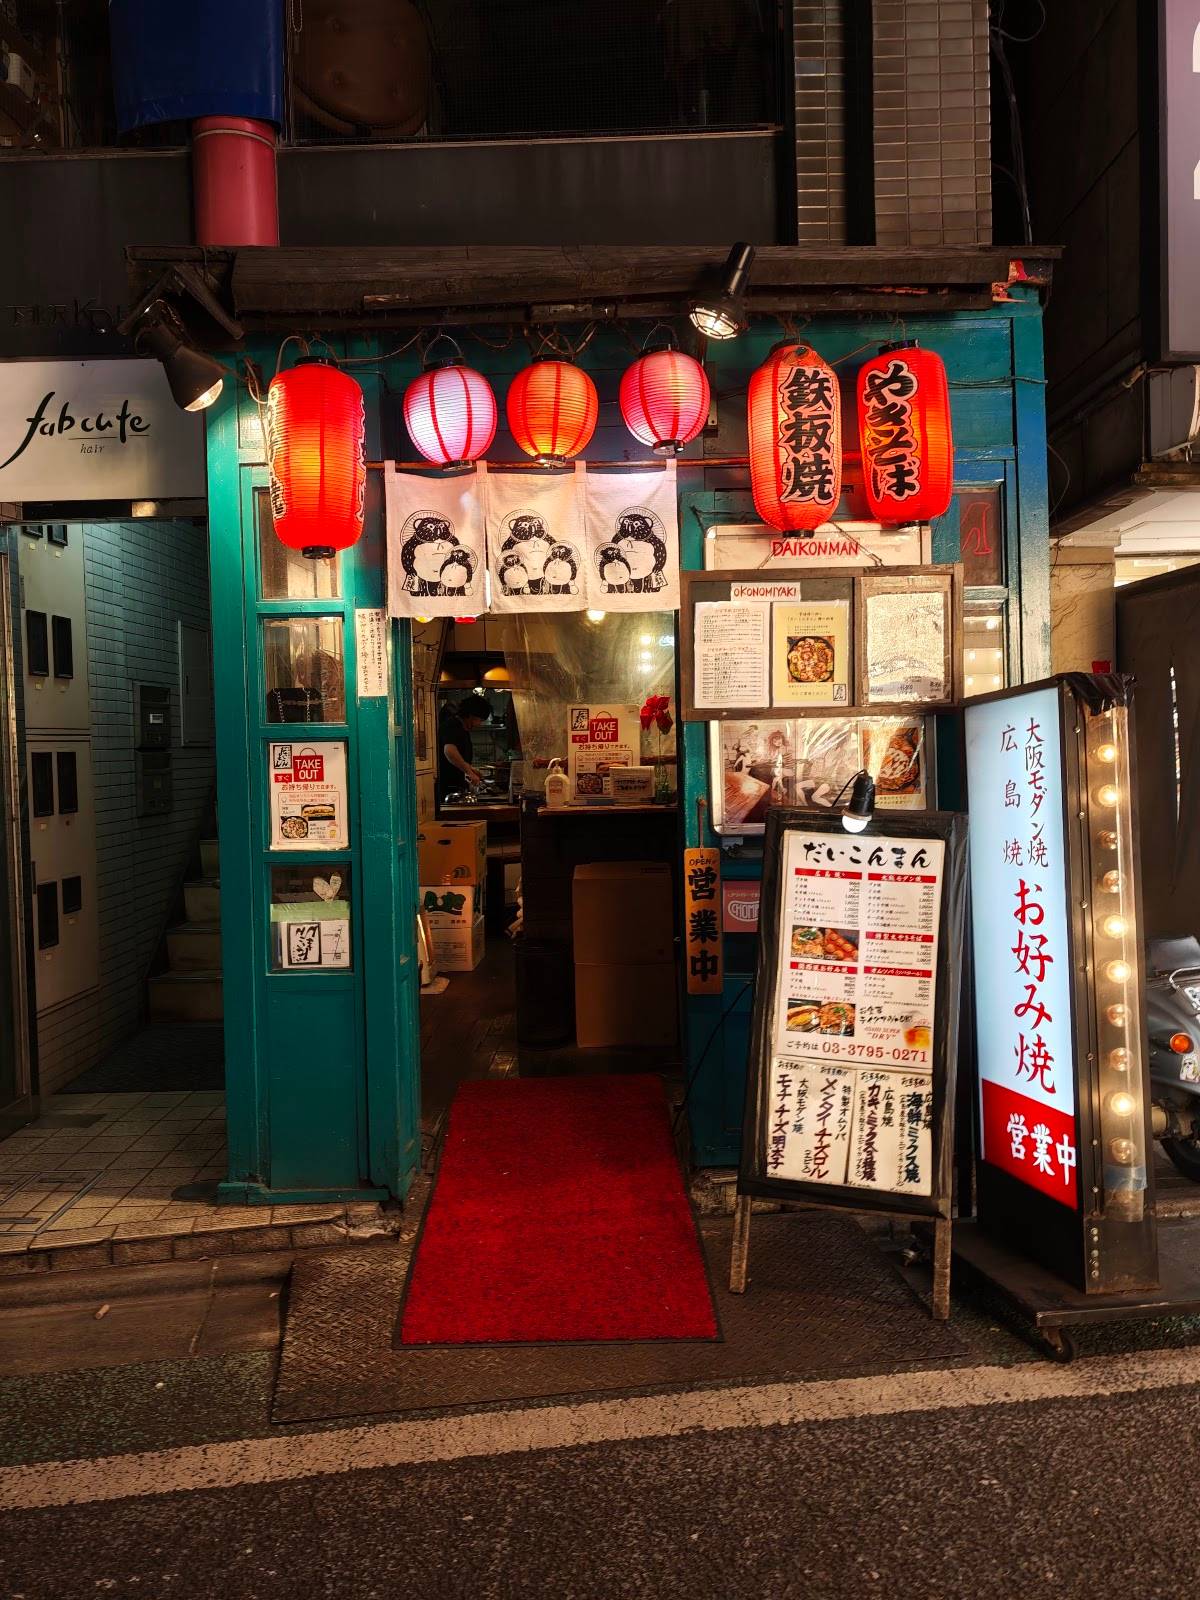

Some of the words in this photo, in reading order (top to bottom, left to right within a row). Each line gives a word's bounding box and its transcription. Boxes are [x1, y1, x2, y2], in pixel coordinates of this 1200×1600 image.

[782, 367, 834, 501] 鉄板焼
[865, 363, 916, 500] やきそば
[80, 442, 105, 455] hair
[771, 540, 860, 557] DAIKONMAN
[733, 585, 798, 599] OKONOMIYAKI
[592, 721, 617, 731] TAKE
[594, 731, 614, 740] OUT
[295, 759, 322, 769] TAKE
[298, 769, 319, 780] OUT
[1000, 725, 1024, 867] 広島焼
[1024, 717, 1049, 868] 大阪モダン焼
[688, 858, 712, 867] OPEN
[803, 841, 932, 870] だいこんまん
[687, 867, 719, 983] 営業中
[1010, 878, 1056, 1095] お好み焼
[786, 1039, 819, 1051] ご予約は
[822, 1041, 928, 1063] 03-3795-0271
[768, 1073, 793, 1170] モチチーズ明太子
[880, 1086, 895, 1128] 広島焼
[1006, 1112, 1077, 1186] 営業中
